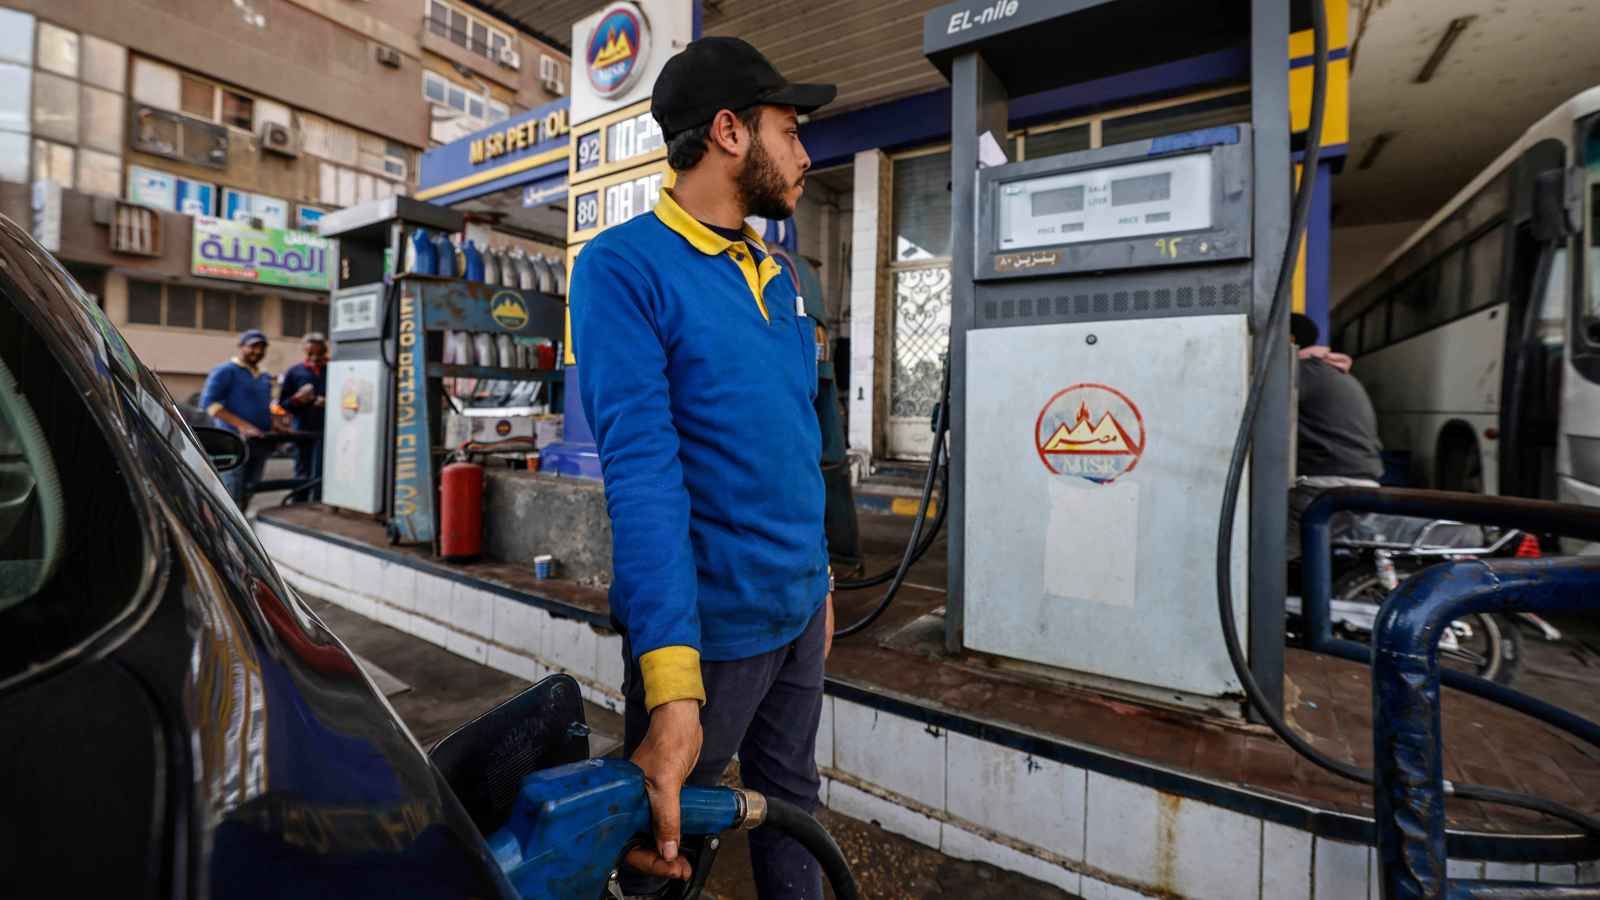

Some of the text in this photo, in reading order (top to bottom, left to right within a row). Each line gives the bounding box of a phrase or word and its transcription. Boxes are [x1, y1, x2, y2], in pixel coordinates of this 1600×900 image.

[947, 0, 1018, 34] EL-nile
[579, 138, 600, 165] 92
[577, 199, 597, 224] 80
[200, 233, 325, 273] المدينة
[1053, 434, 1117, 448] مصر
[1062, 456, 1120, 475] MISR
